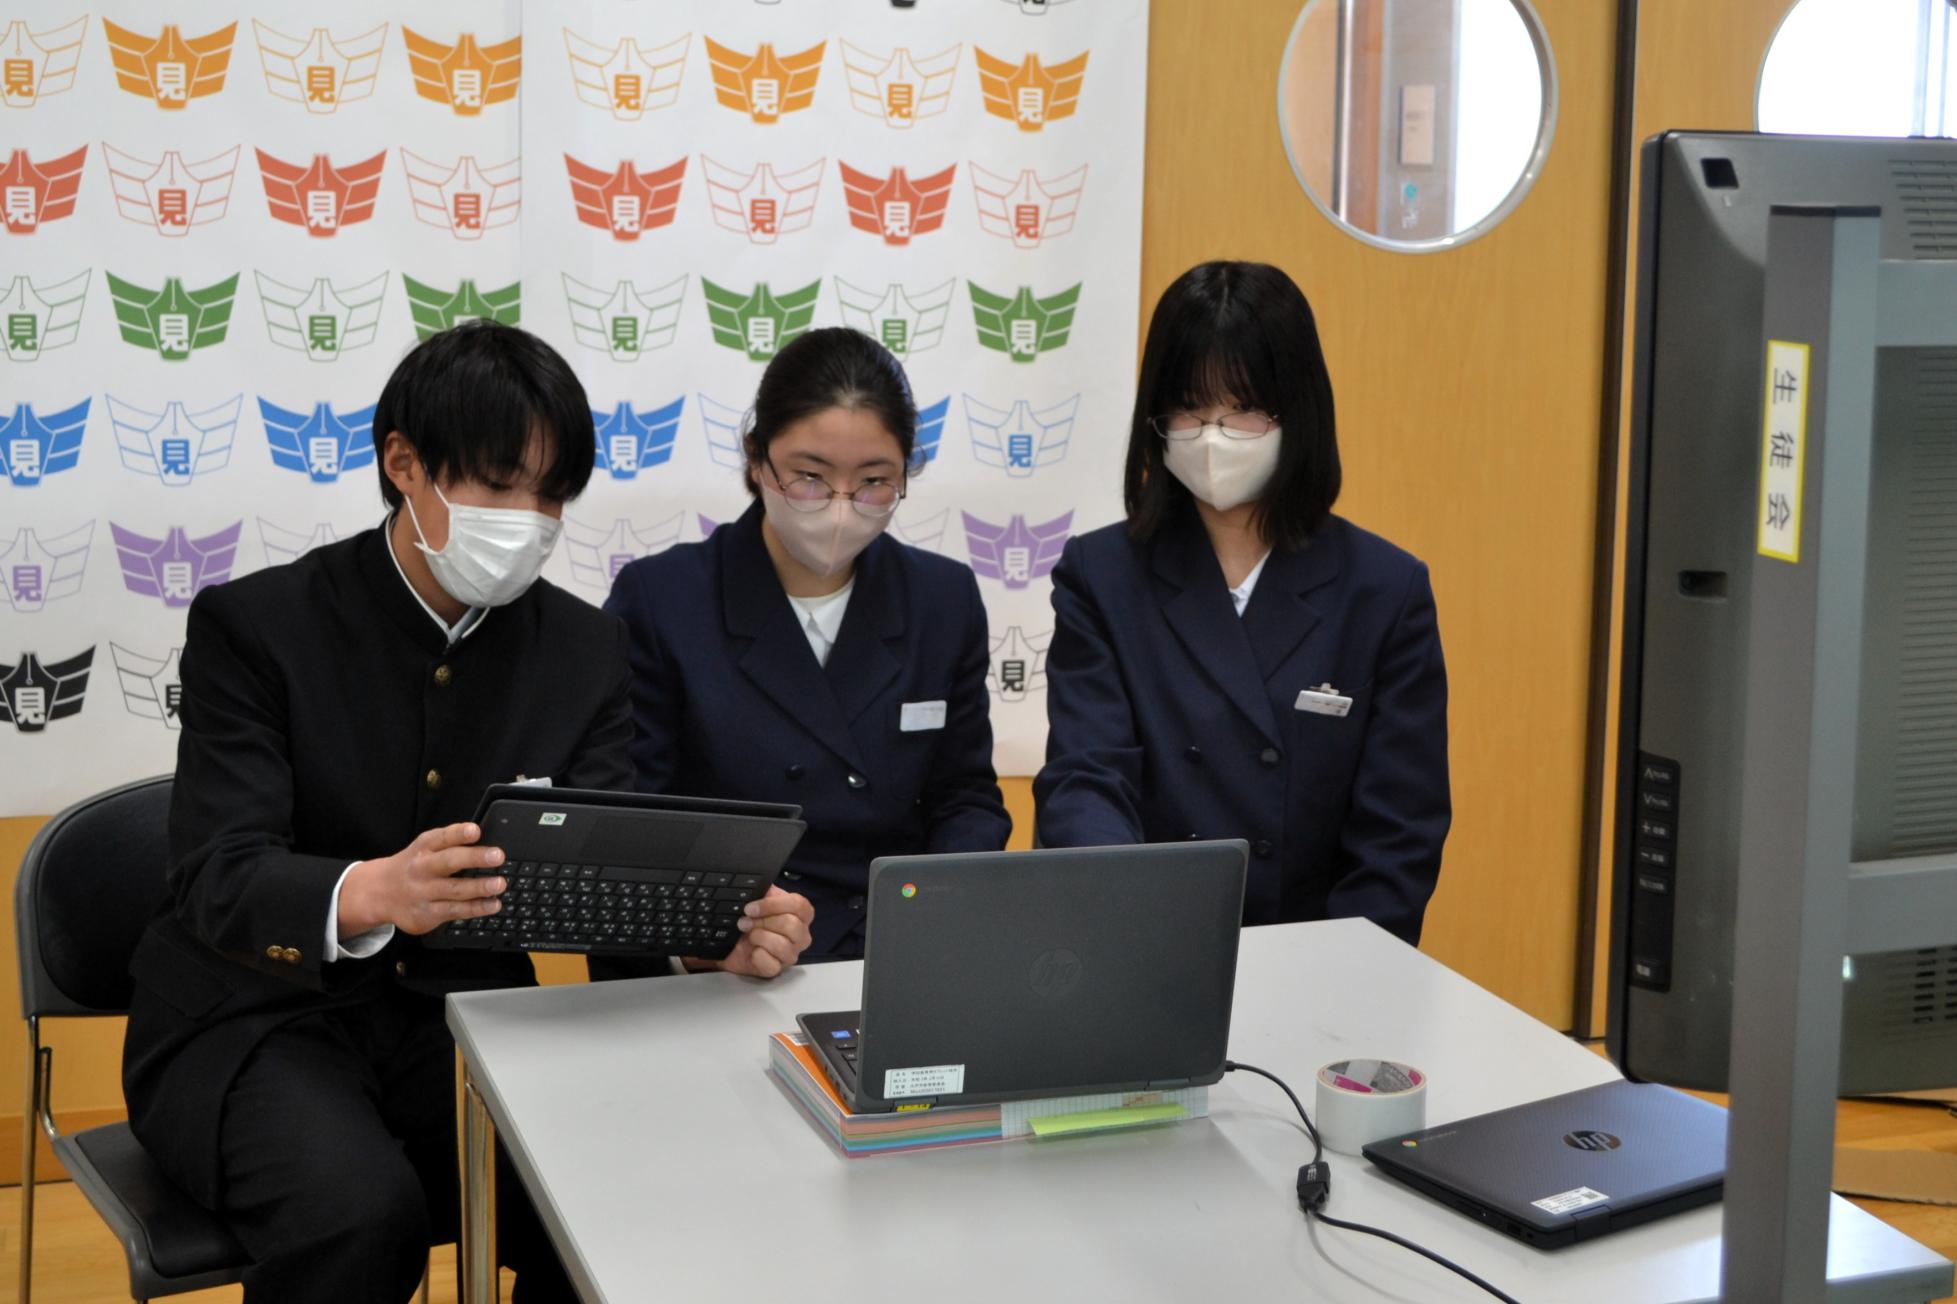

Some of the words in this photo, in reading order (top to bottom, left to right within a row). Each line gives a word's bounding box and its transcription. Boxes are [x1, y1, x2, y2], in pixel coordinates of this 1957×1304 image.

[4, 60, 34, 97] 見
[157, 63, 186, 100] 見
[307, 66, 335, 103] 見
[453, 70, 481, 105] 見
[615, 74, 640, 110] 見
[752, 79, 778, 115] 見
[888, 84, 913, 119] 見
[1018, 88, 1043, 123] 見
[6, 187, 36, 224] 見
[159, 189, 187, 226] 見
[307, 191, 336, 228] 見
[454, 193, 480, 229] 見
[613, 195, 640, 232] 見
[751, 200, 776, 234] 見
[884, 202, 910, 237] 見
[1015, 205, 1040, 239] 見
[8, 314, 37, 351] 見
[160, 314, 188, 351] 見
[309, 316, 336, 351] 見
[612, 317, 638, 352] 見
[748, 317, 777, 354] 見
[882, 319, 906, 352] 見
[1011, 320, 1036, 355] 見
[10, 439, 40, 476] 見
[162, 440, 189, 475] 見
[310, 439, 338, 475] 見
[610, 436, 637, 472] 見
[1008, 435, 1032, 467] 見
[1766, 368, 1797, 531] 生徒会
[163, 562, 192, 598] 見
[1005, 547, 1029, 582] 見
[13, 566, 42, 601] 見
[1002, 660, 1024, 692] 見
[15, 687, 45, 724] 見
[1569, 1131, 1612, 1151] hp
